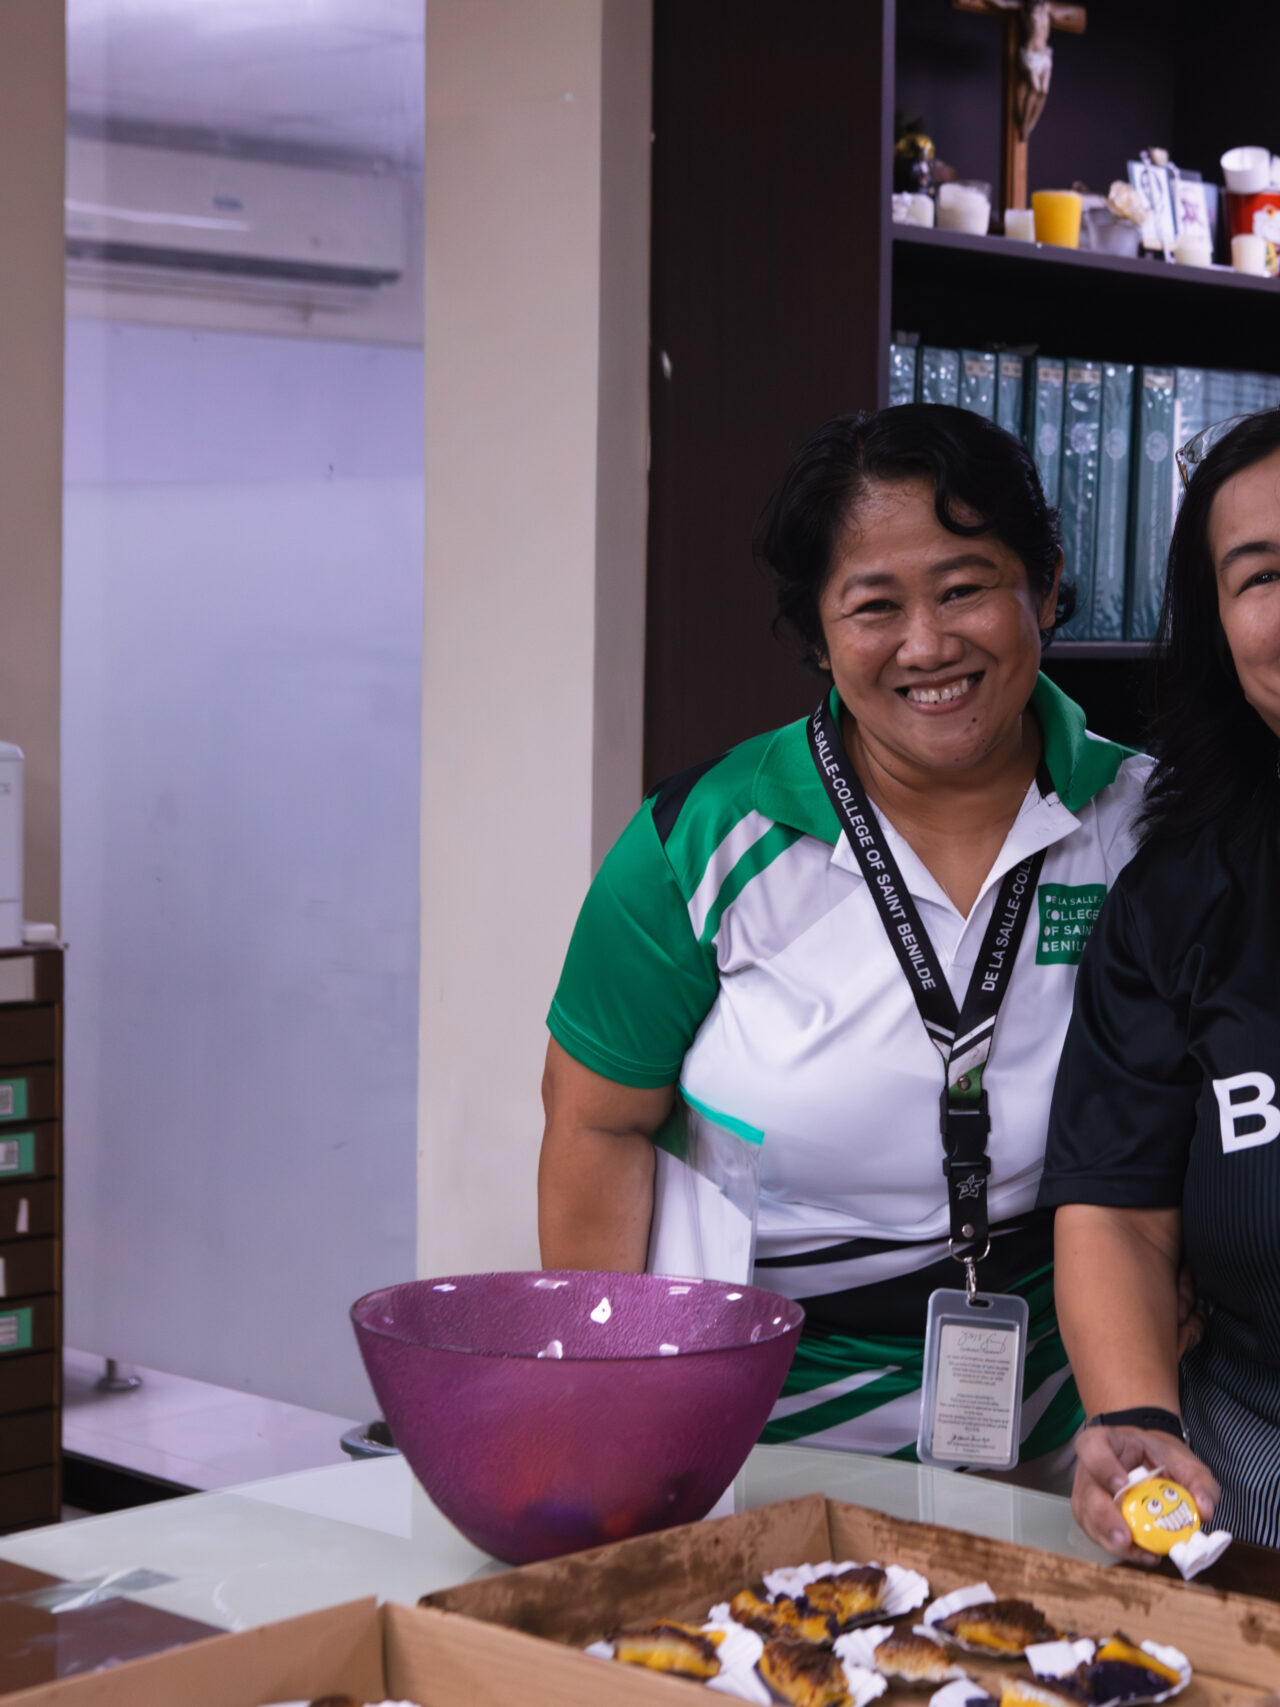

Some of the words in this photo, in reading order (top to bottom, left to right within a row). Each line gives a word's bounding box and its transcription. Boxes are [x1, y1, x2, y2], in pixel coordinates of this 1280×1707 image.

[814, 730, 875, 848] SALLE-COLLEGE
[866, 849, 886, 871] OF
[876, 873, 907, 919] SAINT
[897, 922, 937, 991] BENILDE
[1058, 898, 1068, 906] LA
[1045, 908, 1100, 921] COLLEGE
[1043, 925, 1060, 937] OF
[1063, 924, 1095, 937] SAIN
[1042, 940, 1087, 953] BENIL
[988, 950, 1006, 969] LA
[981, 971, 1000, 992] DE
